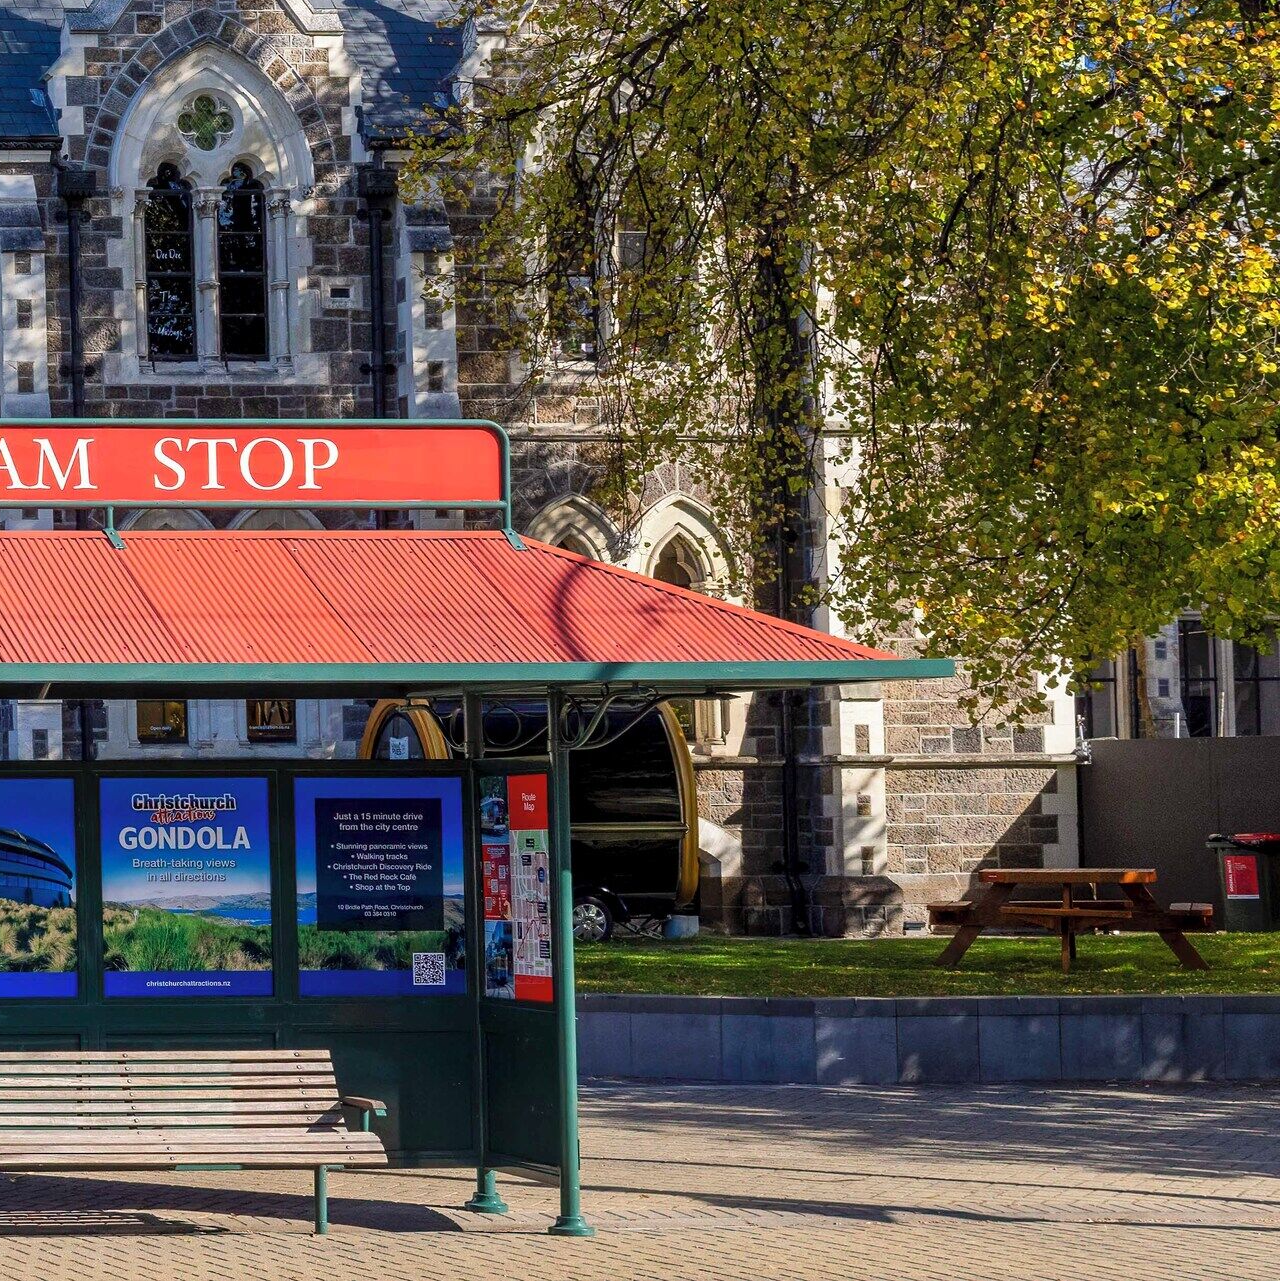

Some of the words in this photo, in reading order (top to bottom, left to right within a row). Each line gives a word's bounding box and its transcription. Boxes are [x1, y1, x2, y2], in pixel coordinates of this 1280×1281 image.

[155, 249, 168, 259] Dee
[169, 249, 181, 259] Dee
[153, 437, 340, 491] STOP
[521, 792, 537, 801] Route
[132, 793, 236, 811] Christchurch
[523, 802, 535, 812] Map
[150, 808, 216, 824] attractions
[333, 812, 352, 821] Just
[361, 813, 371, 821] 15
[373, 812, 401, 821] minute
[402, 812, 424, 821] drive
[339, 823, 358, 831] from
[360, 823, 374, 831] the
[375, 823, 390, 832] city
[392, 823, 419, 831] centre
[119, 826, 251, 850] GONDOLA
[336, 842, 367, 851] Stunning
[368, 842, 406, 851] panoramic
[356, 852, 385, 861] Walking
[132, 858, 203, 870] Breath-taking
[206, 859, 236, 868] views
[379, 863, 414, 872] Discovery
[147, 872, 157, 881] in
[159, 872, 171, 881] all
[174, 872, 226, 882] directions
[349, 873, 363, 881] The
[363, 873, 378, 881] Red
[379, 873, 398, 881] Rock
[399, 872, 417, 881] Café
[355, 883, 374, 892] Shop
[397, 884, 411, 892] Top
